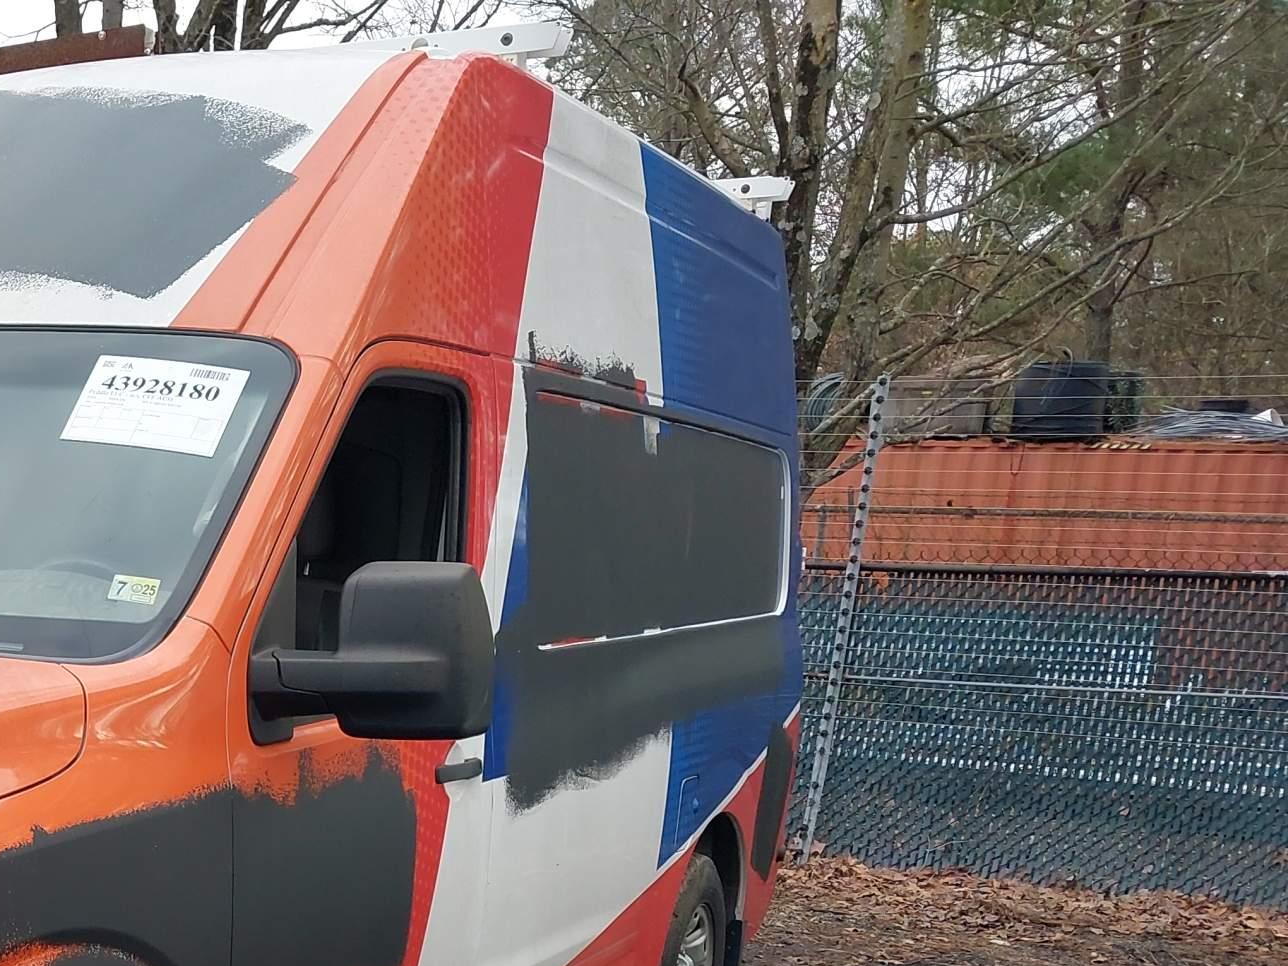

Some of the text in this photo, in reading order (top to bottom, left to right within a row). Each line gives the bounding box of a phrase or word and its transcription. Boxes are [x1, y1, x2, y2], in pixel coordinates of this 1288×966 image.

[101, 373, 221, 402] 43928180
[116, 580, 157, 596] 7 25
